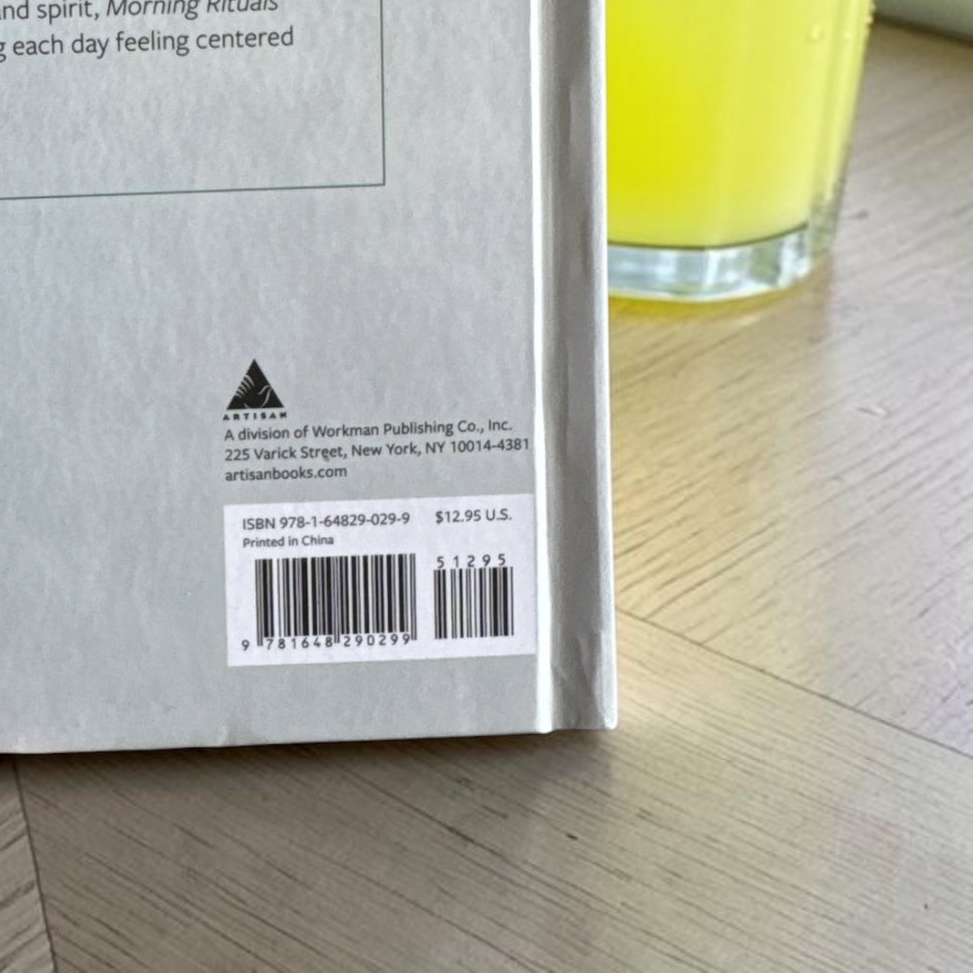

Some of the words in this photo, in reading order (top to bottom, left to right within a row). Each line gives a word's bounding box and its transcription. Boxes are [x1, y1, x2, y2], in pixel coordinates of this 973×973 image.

[13, 33, 64, 56] each
[71, 33, 109, 59] day
[115, 30, 190, 57] feeling
[196, 25, 293, 50] centered
[222, 411, 287, 421] ARTISAN
[224, 429, 235, 441] A
[238, 427, 290, 441] division
[294, 425, 309, 439] of
[312, 424, 379, 438] Workman
[384, 421, 454, 437] Publishing
[457, 420, 484, 434] Co.,
[488, 419, 512, 431] Inc.
[225, 448, 250, 461] 225
[254, 446, 297, 460] Varick
[300, 446, 347, 462] Street,
[351, 444, 382, 456] New
[386, 441, 421, 457] York,
[425, 441, 445, 454] NY
[451, 438, 529, 453] 10014-4381
[225, 466, 347, 481] artisanbooks.com
[243, 518, 276, 531] ISBN
[279, 512, 410, 529] 978-1-64829-029-9
[435, 509, 481, 525] $12.95
[486, 508, 512, 521] U.S.
[243, 536, 285, 548] Printed
[288, 536, 299, 546] in
[301, 535, 334, 546] China
